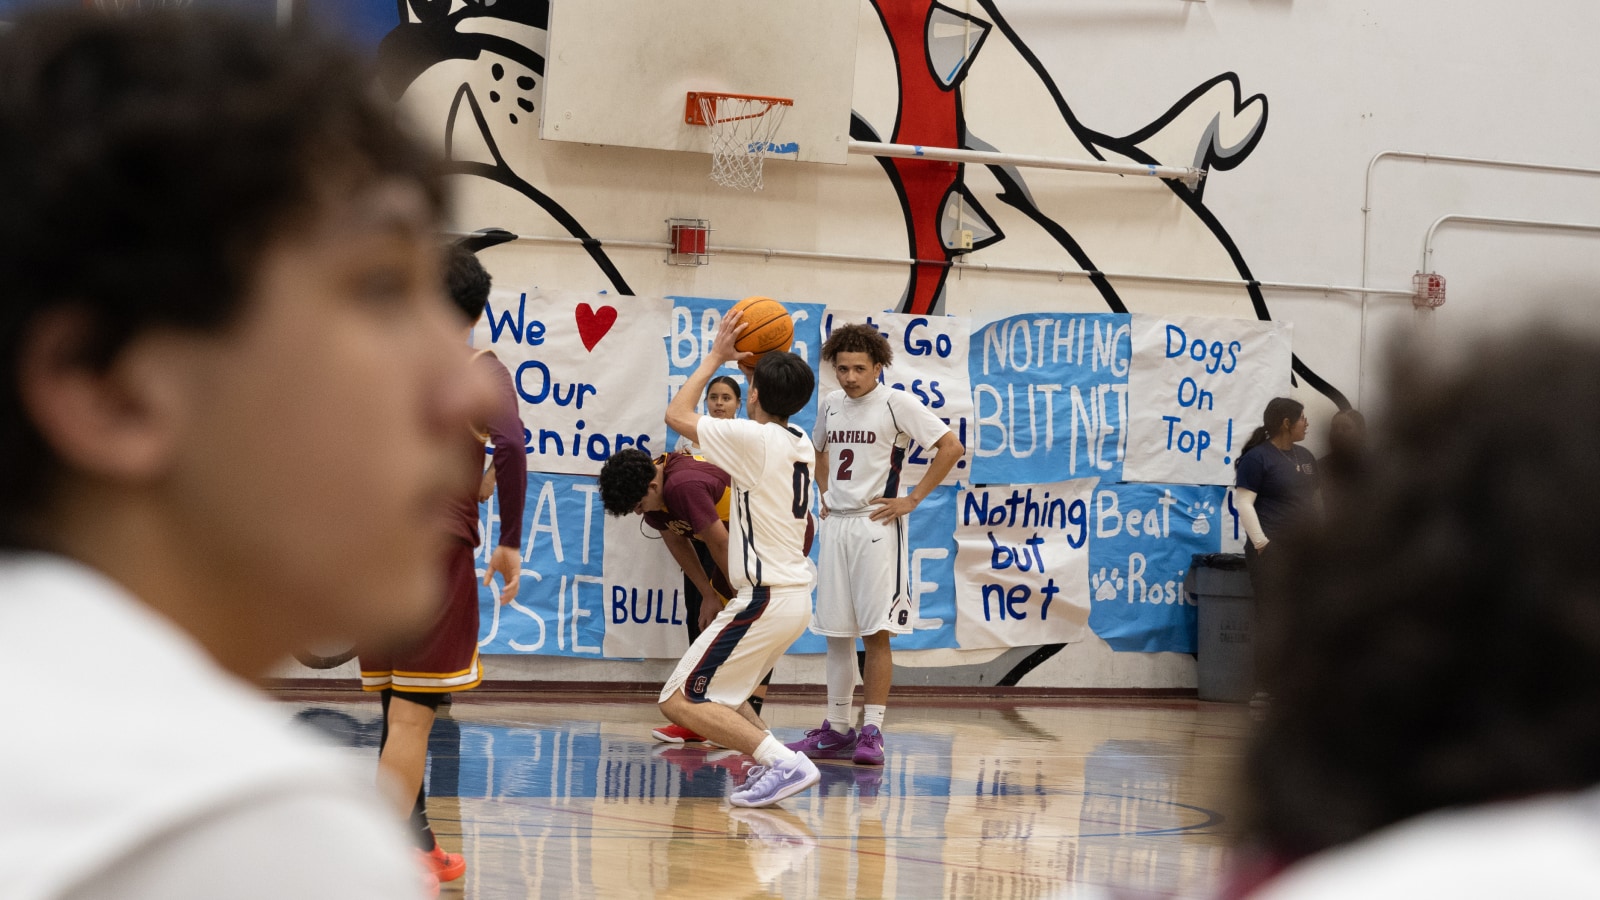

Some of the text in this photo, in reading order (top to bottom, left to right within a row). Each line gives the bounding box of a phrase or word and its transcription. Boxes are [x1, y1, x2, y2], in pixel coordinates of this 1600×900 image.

[485, 293, 546, 346] We
[904, 318, 952, 358] Go
[983, 318, 1131, 377] NOTHING
[1166, 324, 1241, 374] Dogs
[515, 360, 597, 409] Our
[1177, 377, 1213, 410] On
[974, 383, 1062, 458] BUT
[1069, 383, 1129, 476] NET
[792, 460, 810, 519] 0
[836, 448, 855, 481] 2
[964, 488, 1087, 549] Nothing
[1096, 488, 1178, 539] Beat
[987, 531, 1045, 573] but
[982, 578, 1060, 621] net
